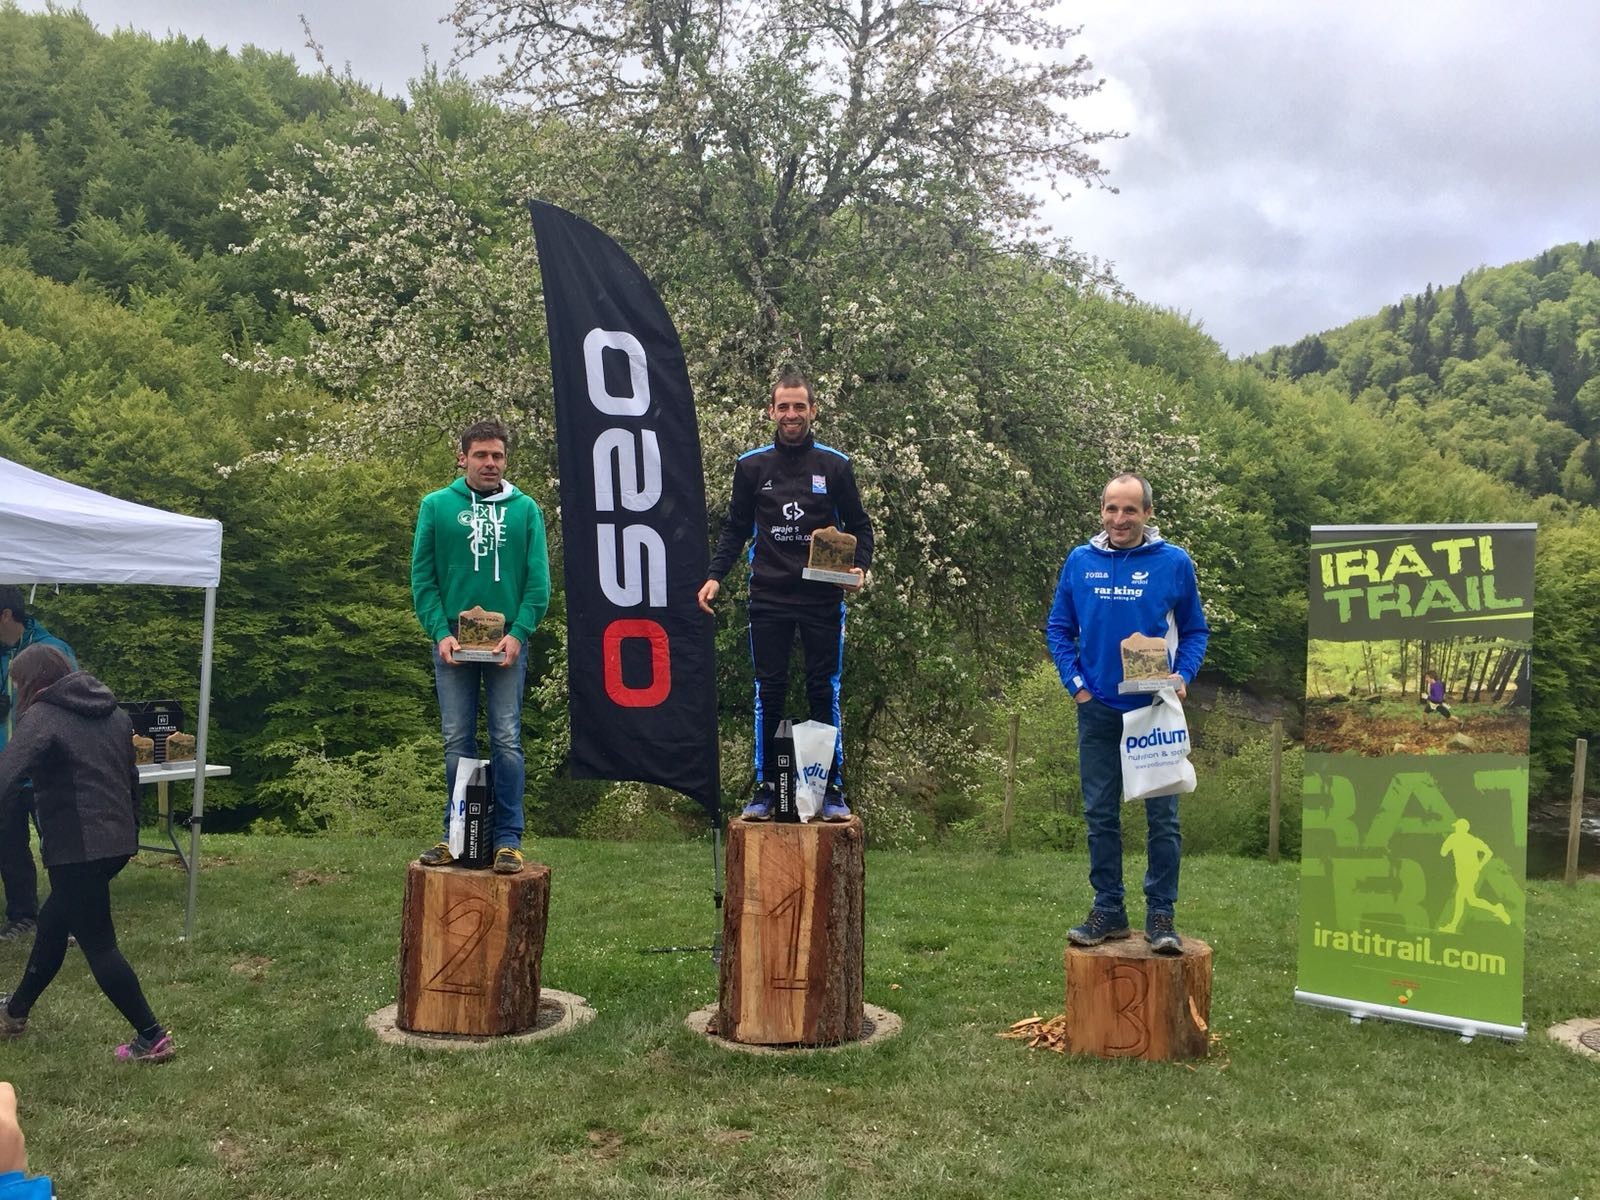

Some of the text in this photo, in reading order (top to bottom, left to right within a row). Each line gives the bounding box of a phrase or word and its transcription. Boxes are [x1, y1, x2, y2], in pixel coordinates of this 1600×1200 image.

[1320, 535, 1494, 588] IRATI
[1323, 575, 1524, 623] TRAIL
[1126, 728, 1187, 754] podium
[423, 896, 497, 996] 2
[768, 885, 808, 990] 1
[1314, 921, 1506, 975] iratitrail.com
